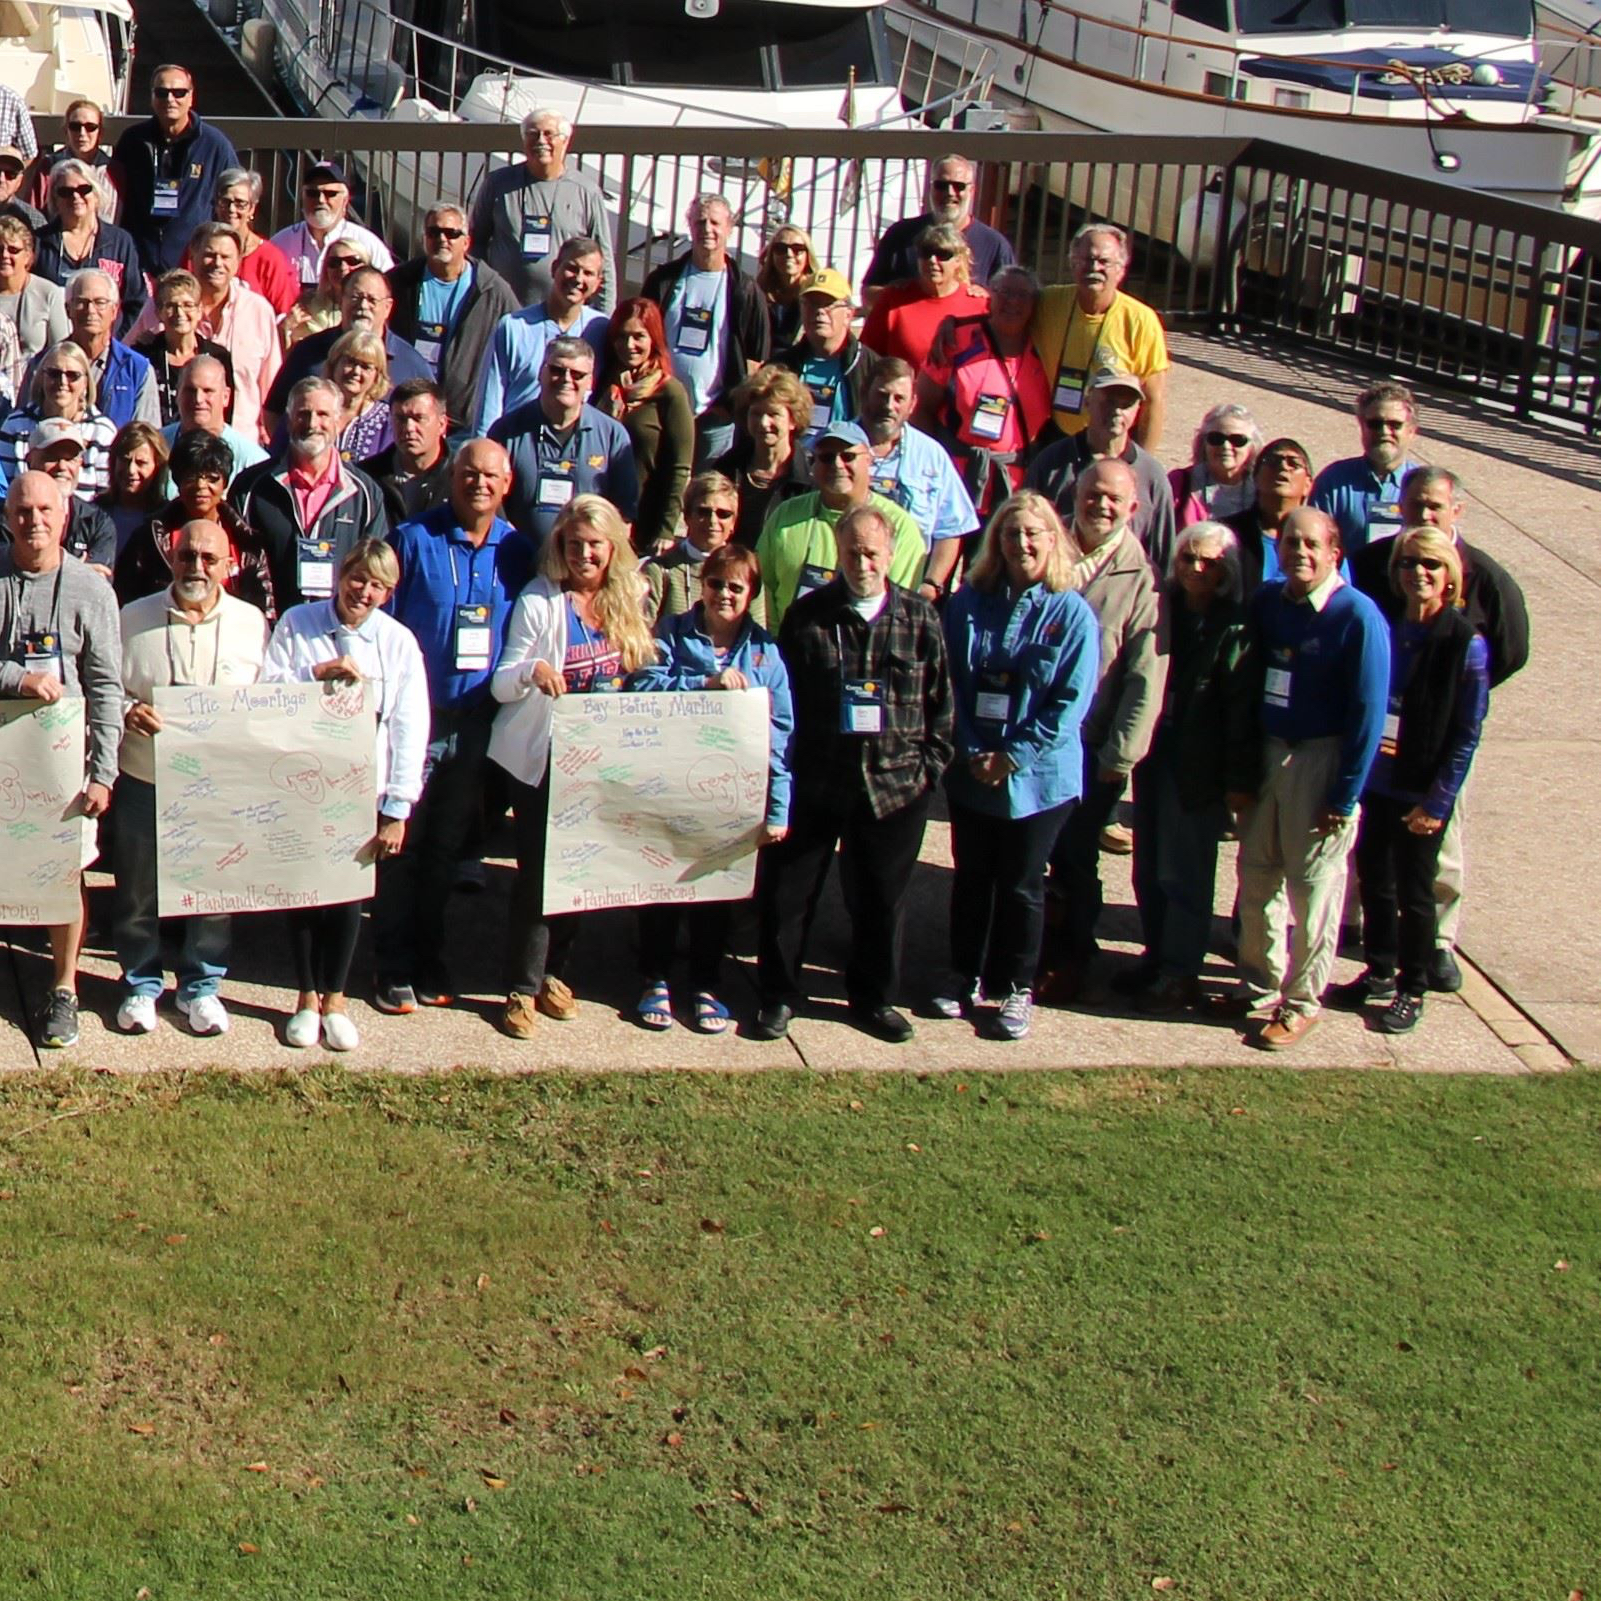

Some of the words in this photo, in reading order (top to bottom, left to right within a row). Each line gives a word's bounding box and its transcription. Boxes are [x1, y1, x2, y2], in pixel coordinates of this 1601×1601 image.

[184, 692, 221, 716] The
[230, 688, 308, 717] Moorings
[582, 697, 610, 723] Bay
[619, 695, 663, 719] Point
[669, 694, 725, 717] Marina
